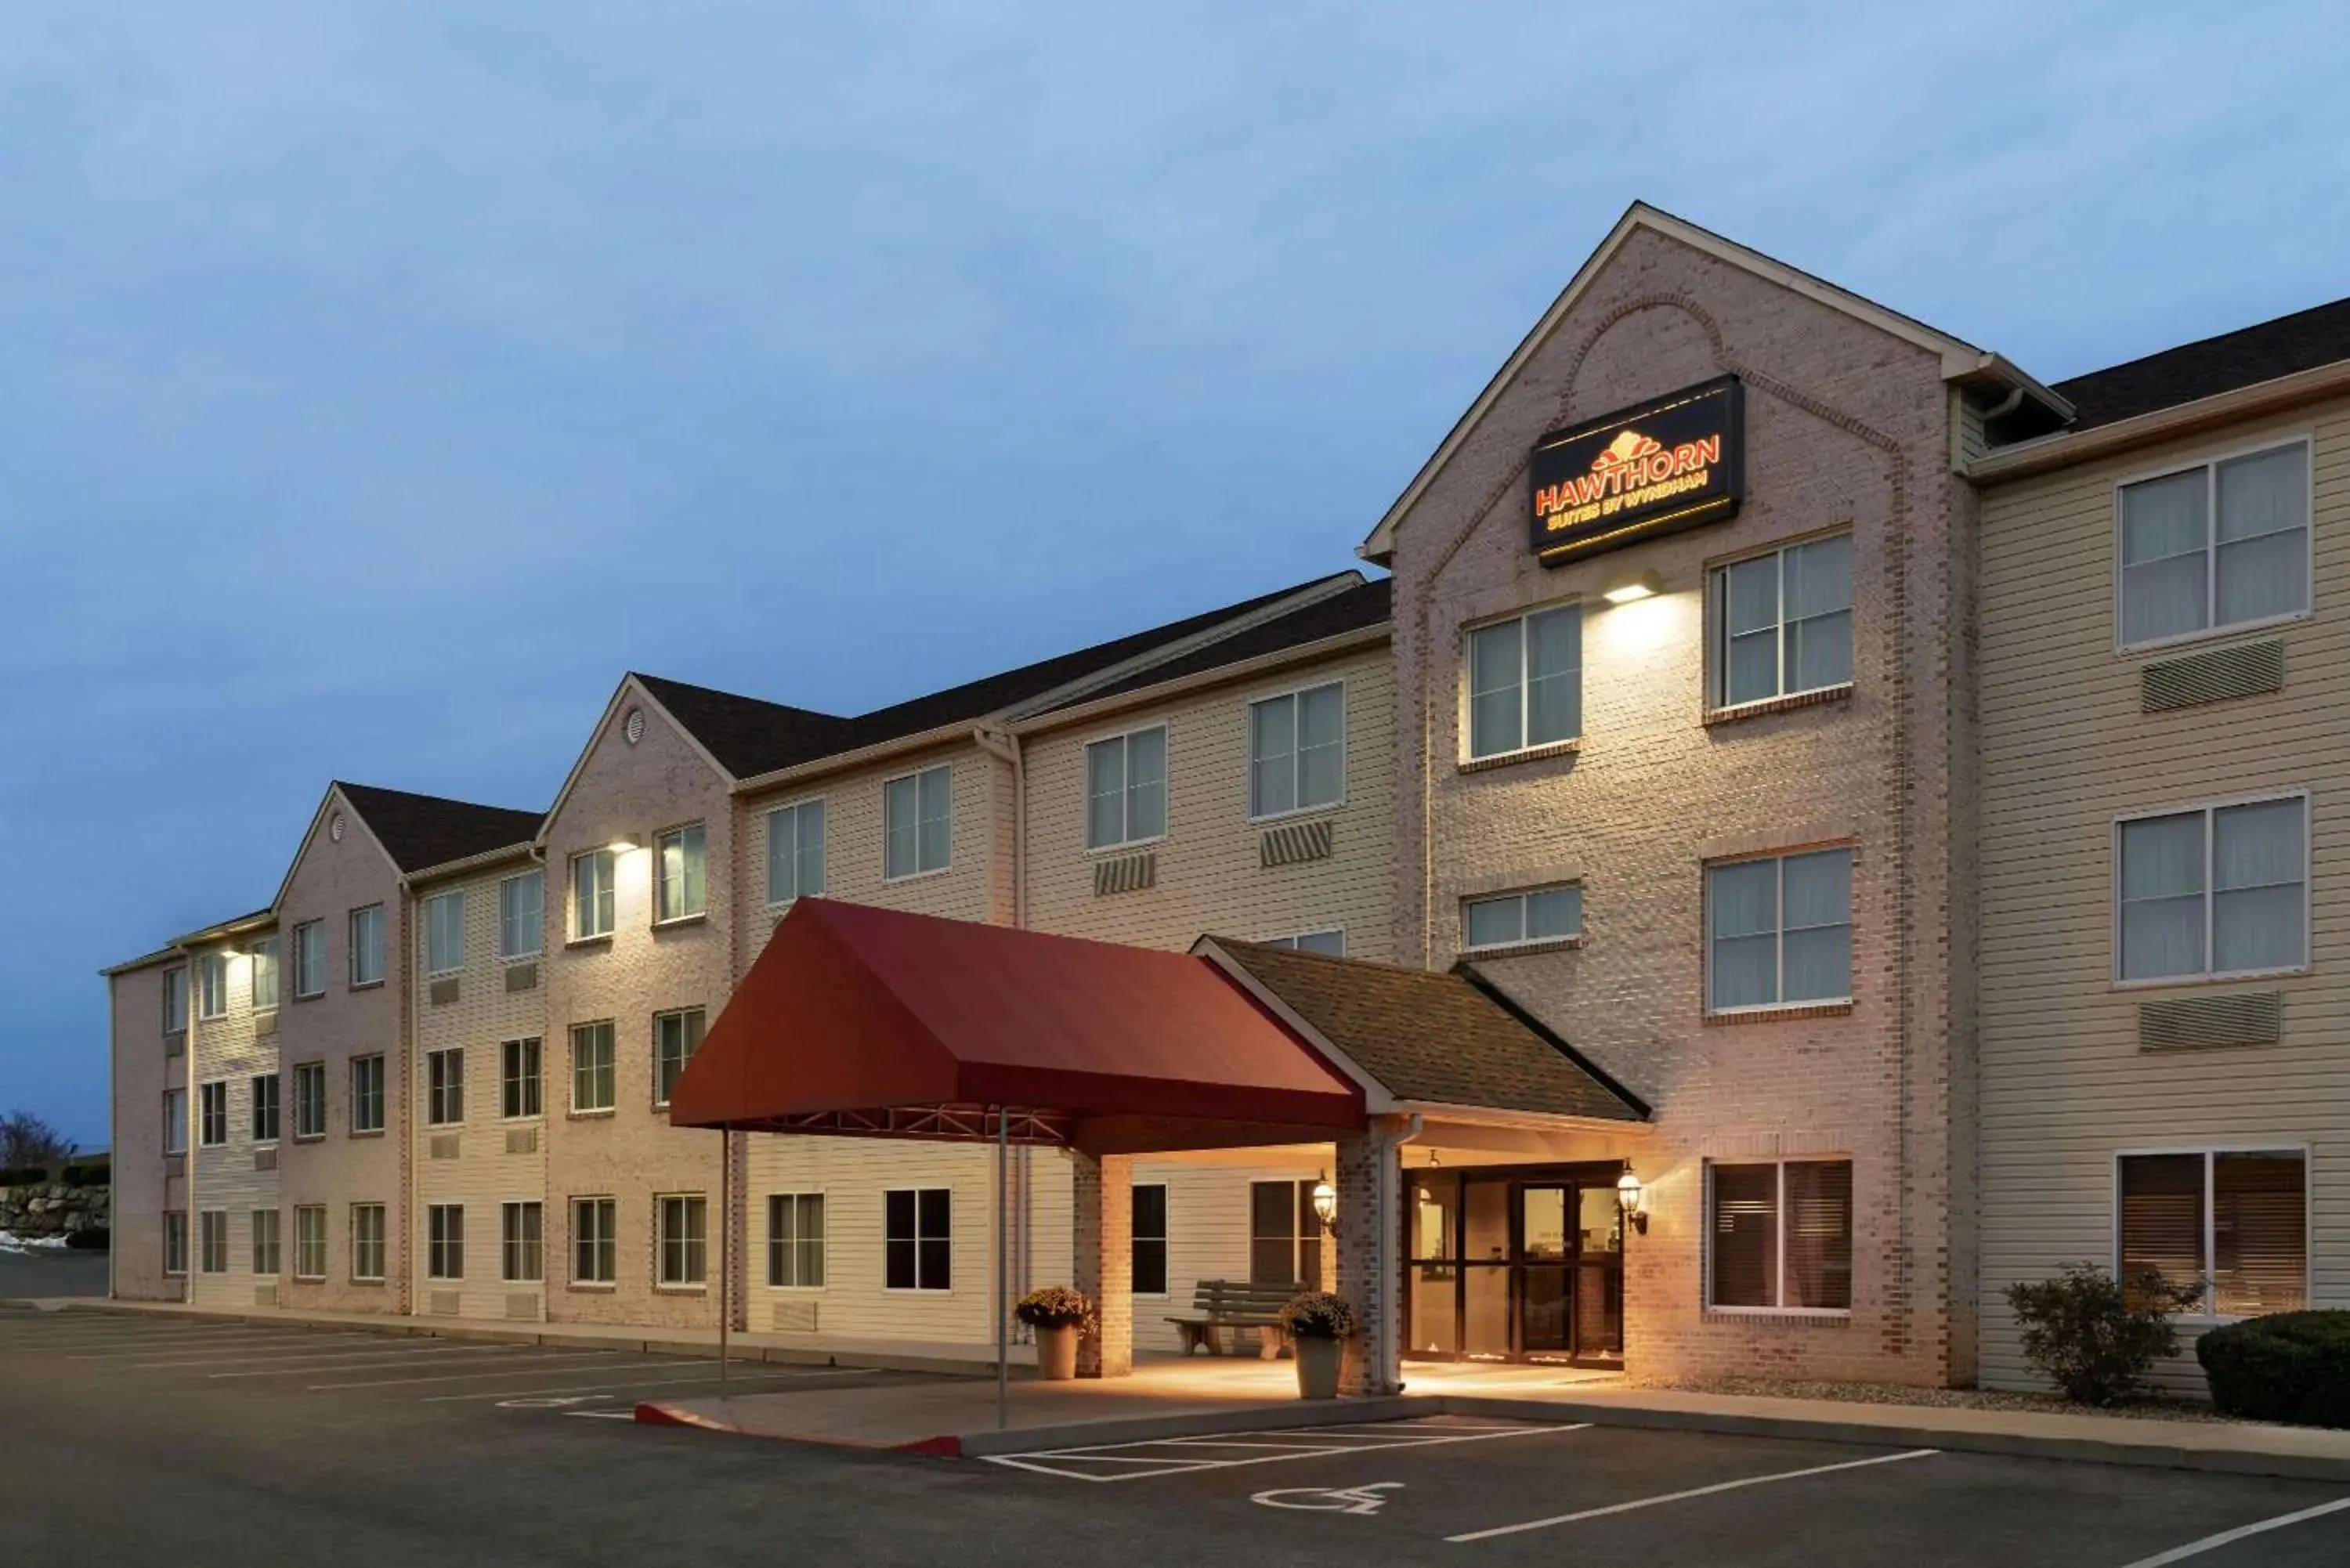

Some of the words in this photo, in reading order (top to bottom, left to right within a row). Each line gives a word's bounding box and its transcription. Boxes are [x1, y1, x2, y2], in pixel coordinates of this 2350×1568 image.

[1535, 434, 1720, 517] HAWTHORN
[1546, 502, 1601, 531] SUITES
[1602, 494, 1625, 515] BY
[1624, 469, 1708, 508] WYNDHAM
